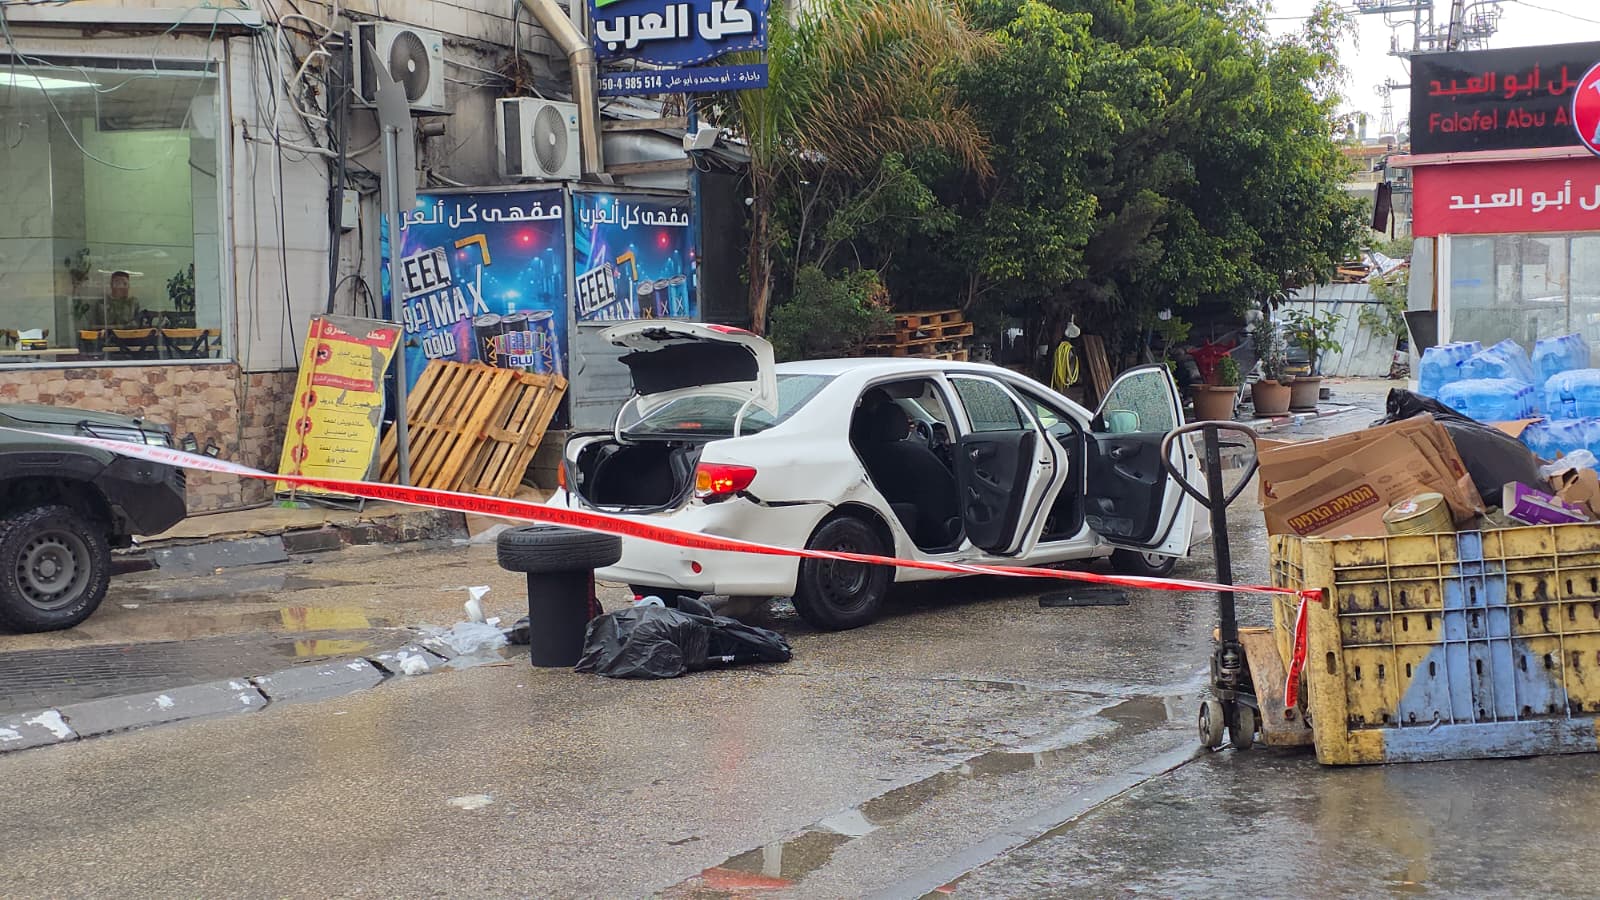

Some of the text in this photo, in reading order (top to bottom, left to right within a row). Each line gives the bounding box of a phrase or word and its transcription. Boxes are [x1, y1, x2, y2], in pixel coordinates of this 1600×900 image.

[596, 0, 753, 50] كل العرب
[625, 77, 642, 89] 985
[644, 75, 662, 88] 514
[1429, 71, 1496, 101] العبد
[1503, 61, 1540, 99] أبو
[1428, 108, 1498, 134] Falafel
[1505, 106, 1546, 130] Abu
[1449, 187, 1523, 214] العبد
[1531, 179, 1571, 213] أبو
[396, 199, 562, 231] مقهى كل ألعر
[621, 204, 640, 230] كل
[642, 207, 689, 227] مقهى
[402, 251, 451, 293] EEL
[429, 263, 490, 329] MAX
[578, 267, 615, 314] FEEL
[510, 356, 533, 365] BLU
